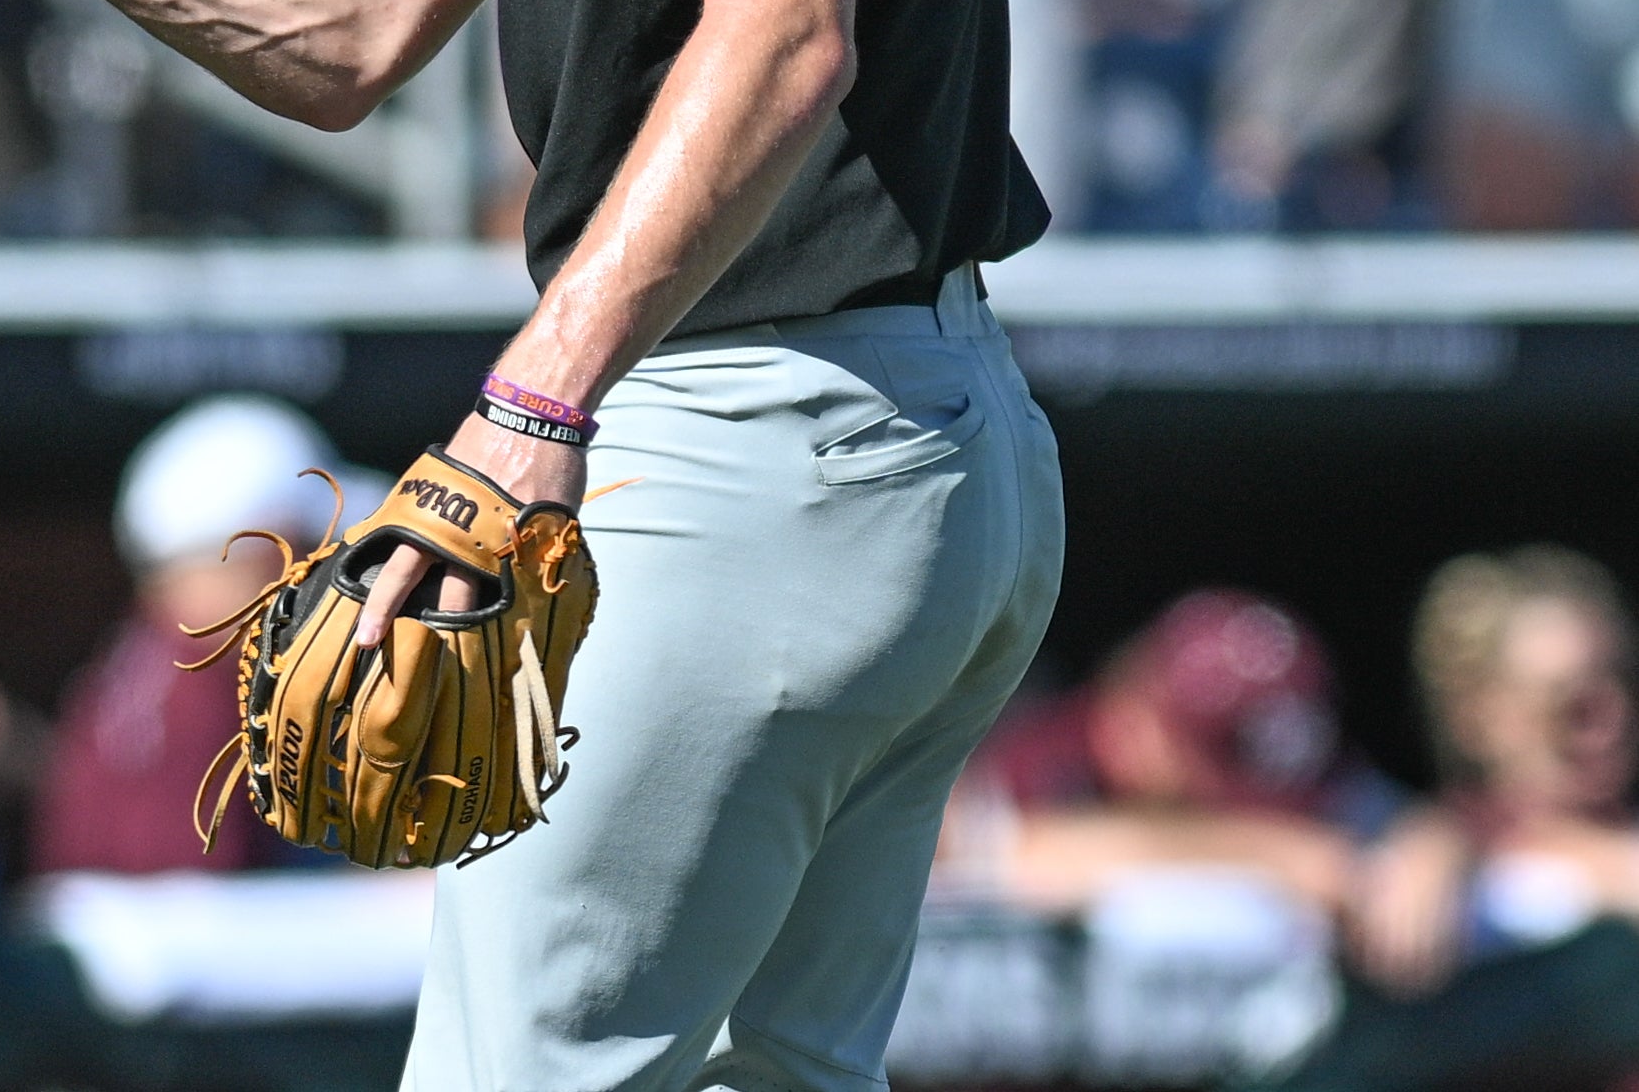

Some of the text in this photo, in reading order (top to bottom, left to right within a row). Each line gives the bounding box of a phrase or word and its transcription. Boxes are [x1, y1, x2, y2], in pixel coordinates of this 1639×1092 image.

[517, 391, 564, 417] CURE
[487, 405, 527, 431] GOING
[551, 425, 581, 443] KEEP
[398, 478, 478, 533] Wilson
[278, 718, 303, 809] A2000
